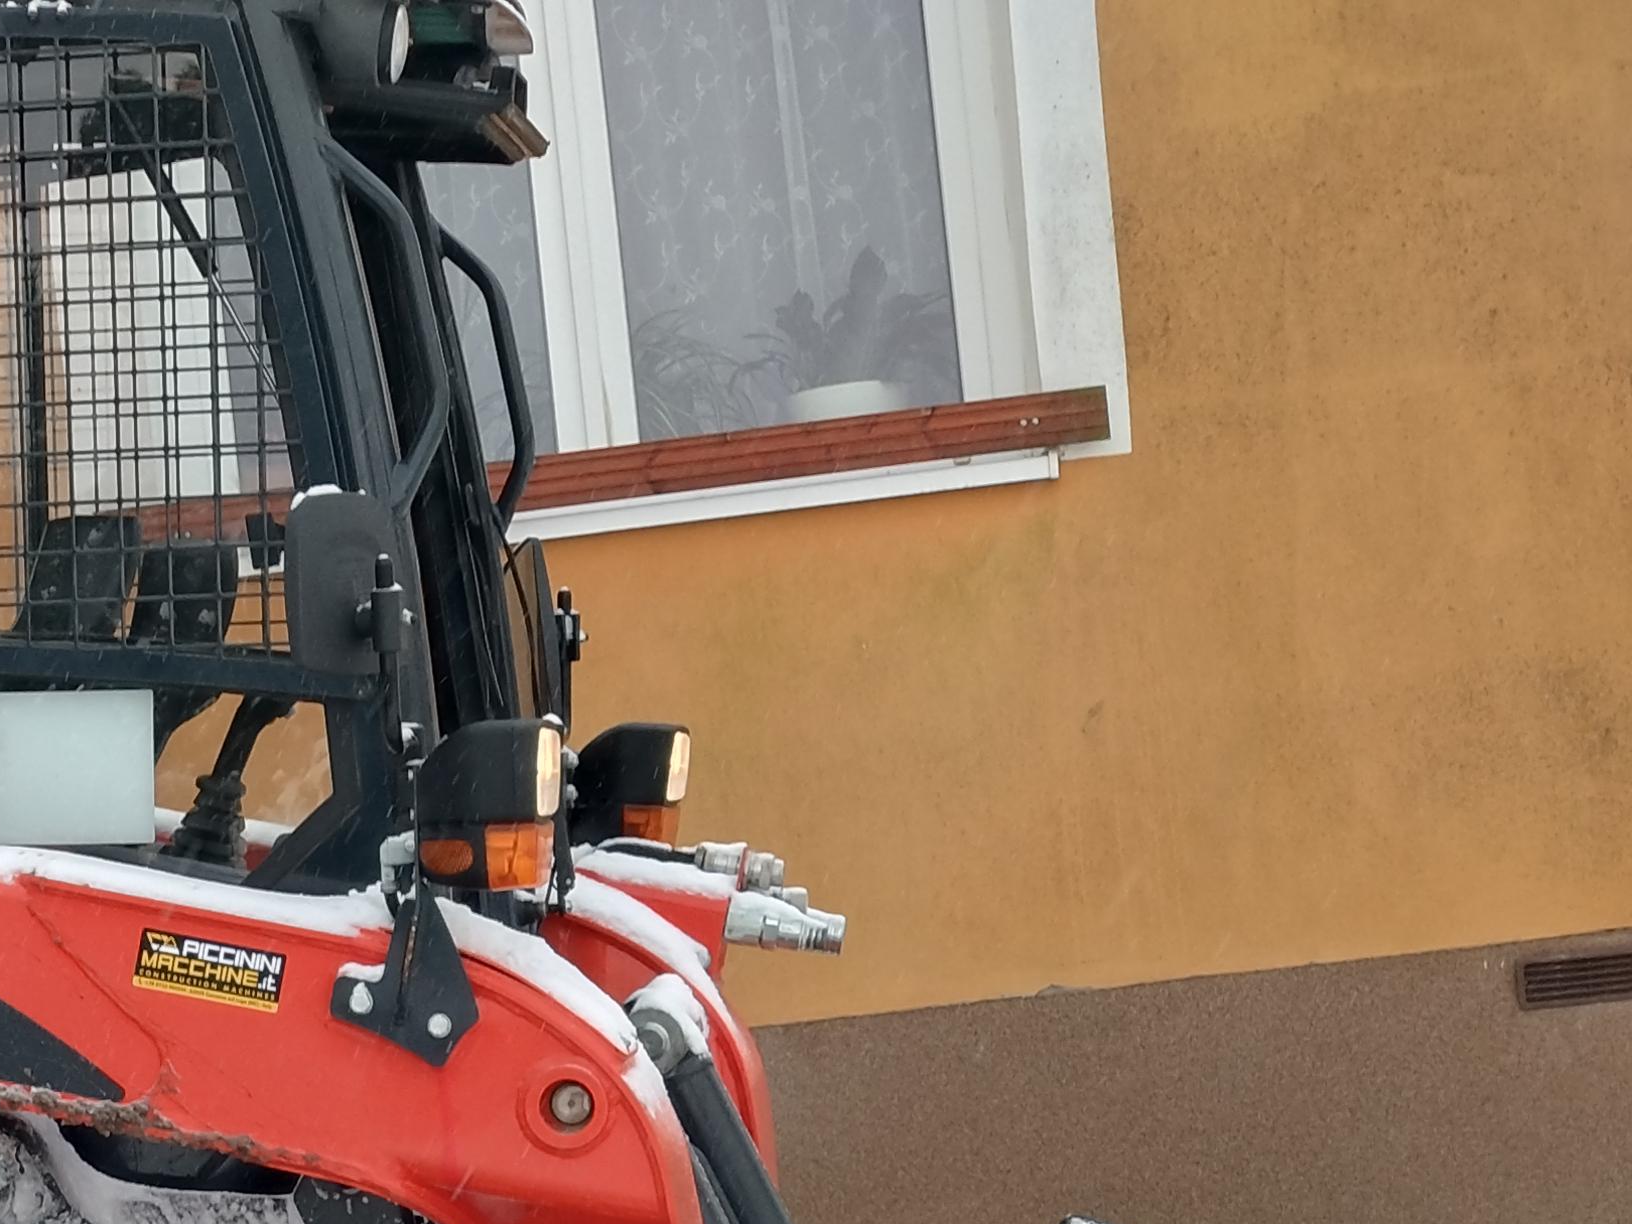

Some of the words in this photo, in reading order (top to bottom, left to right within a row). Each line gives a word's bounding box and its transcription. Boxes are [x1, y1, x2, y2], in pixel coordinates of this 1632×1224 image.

[182, 938, 283, 976] PICCININI
[138, 967, 219, 990] CONSTRUCTION
[223, 983, 277, 1001] MACHINES
